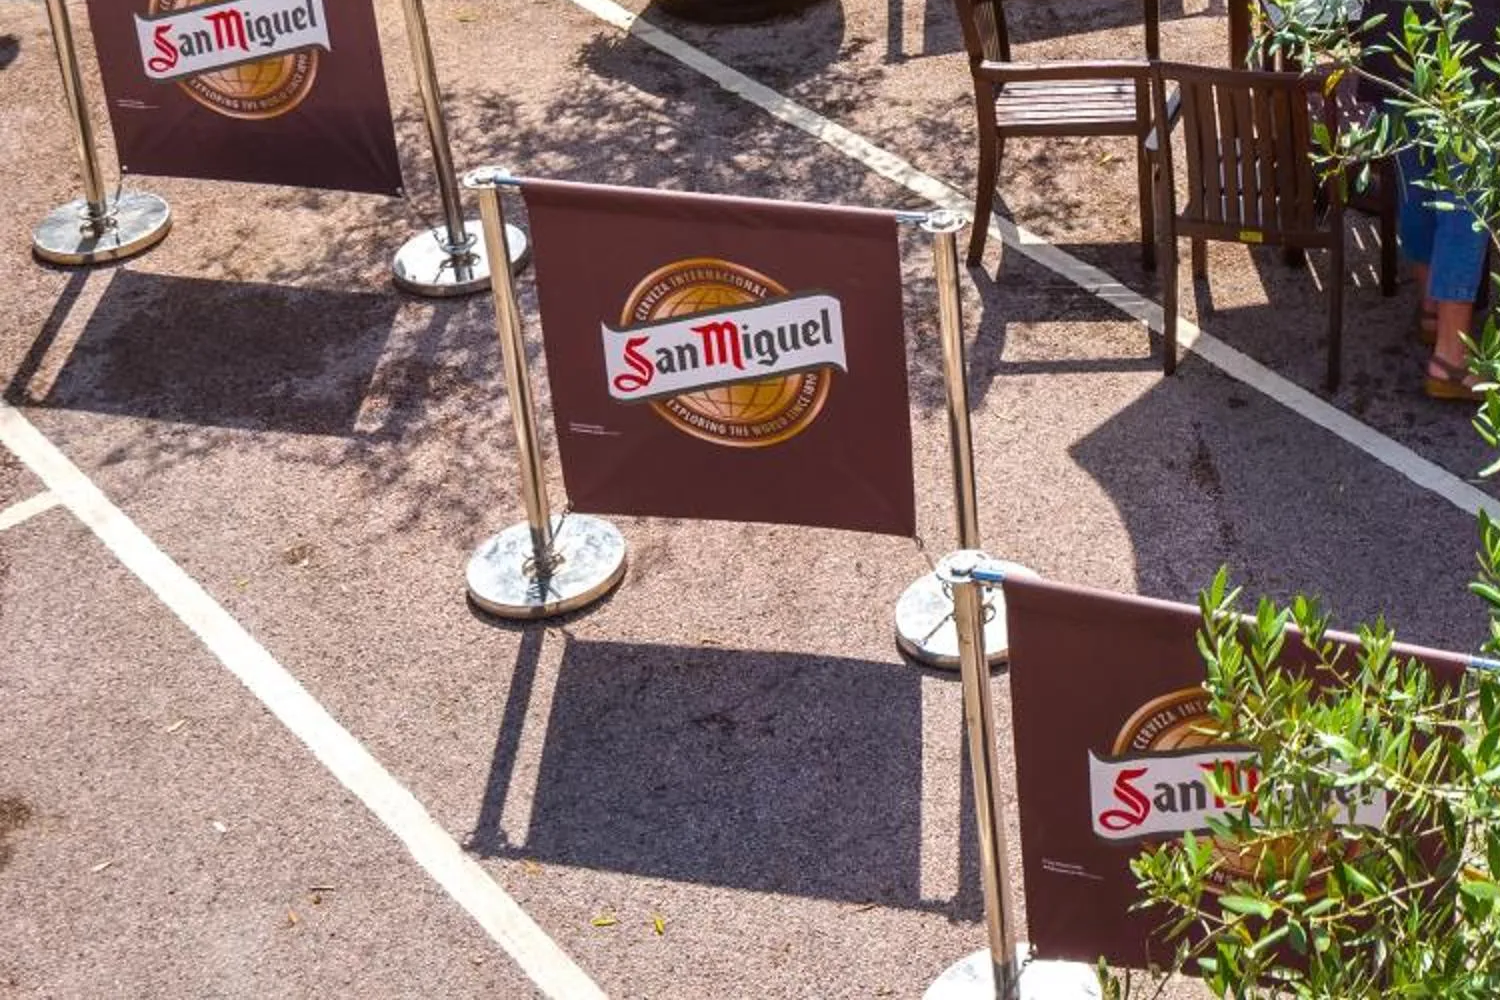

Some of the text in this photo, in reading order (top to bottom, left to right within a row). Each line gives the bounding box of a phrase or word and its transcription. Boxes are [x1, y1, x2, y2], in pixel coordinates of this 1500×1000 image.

[148, 25, 212, 72] San
[613, 308, 833, 392] San Miguel
[1133, 711, 1177, 749] CERVEZA
[1099, 767, 1207, 831] San
